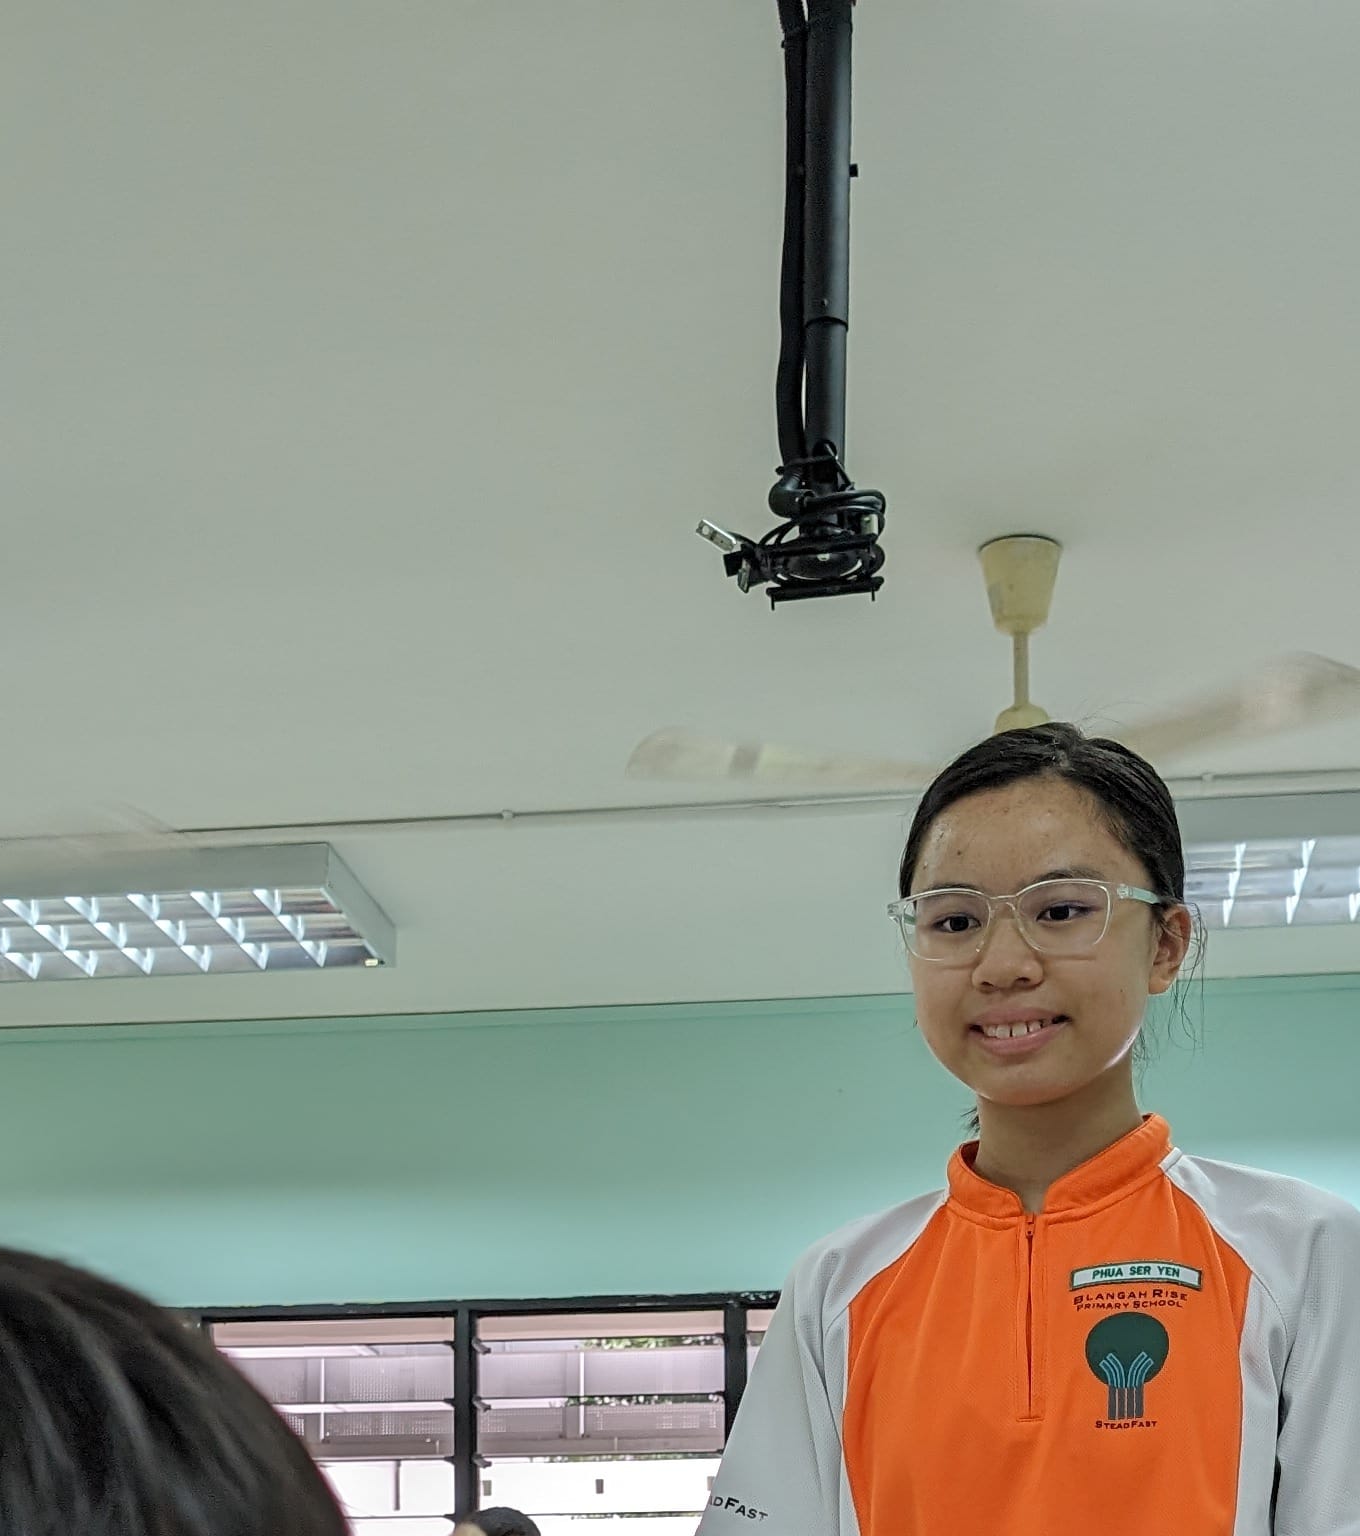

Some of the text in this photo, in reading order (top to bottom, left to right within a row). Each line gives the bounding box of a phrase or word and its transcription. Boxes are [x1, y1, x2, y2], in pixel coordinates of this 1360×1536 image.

[1092, 1266, 1180, 1280] PHUA SER YEN
[1073, 1289, 1189, 1306] BLANGAH RISE
[1076, 1300, 1184, 1312] PRIMARY SCHOOL
[1095, 1420, 1158, 1430] STEADFAST
